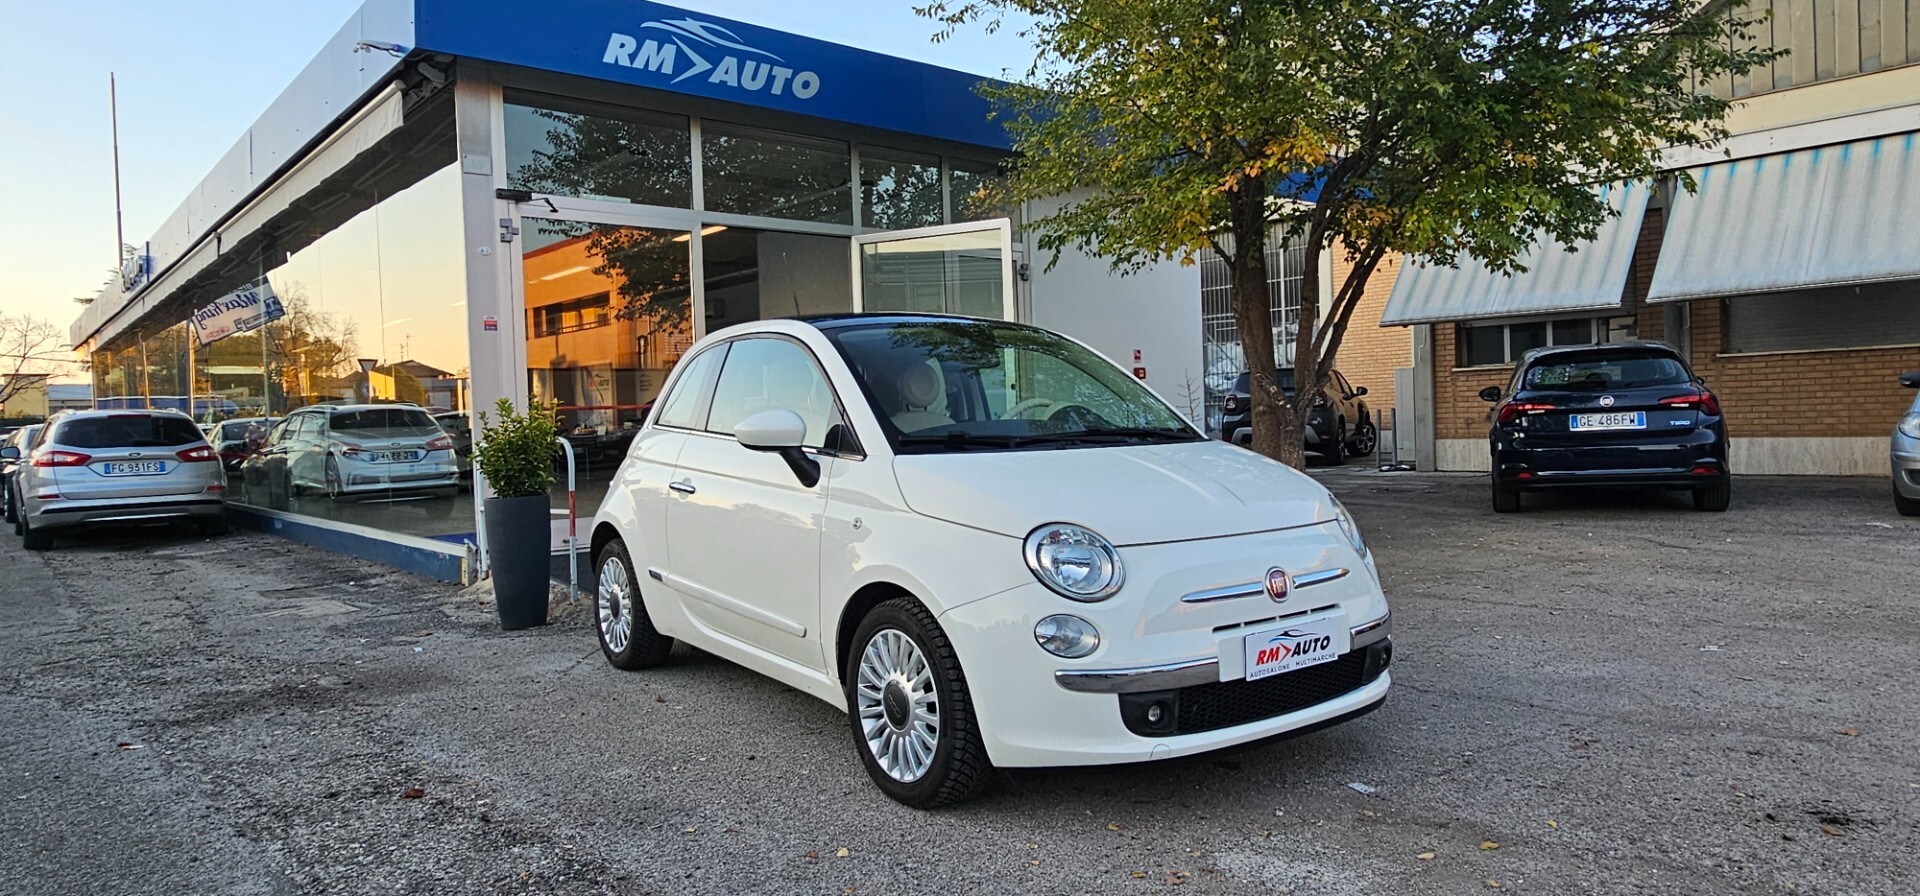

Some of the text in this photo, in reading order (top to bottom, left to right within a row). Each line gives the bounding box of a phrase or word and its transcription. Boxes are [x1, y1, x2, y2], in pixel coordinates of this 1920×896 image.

[707, 55, 821, 100] AUTO
[1579, 413, 1636, 427] GE 486FW
[111, 462, 160, 473] FG 931FS
[1271, 578, 1286, 594] FIAT
[1255, 635, 1331, 666] RM AUTO
[1250, 652, 1336, 679] AUTOSALONE MULTIMARCHE
